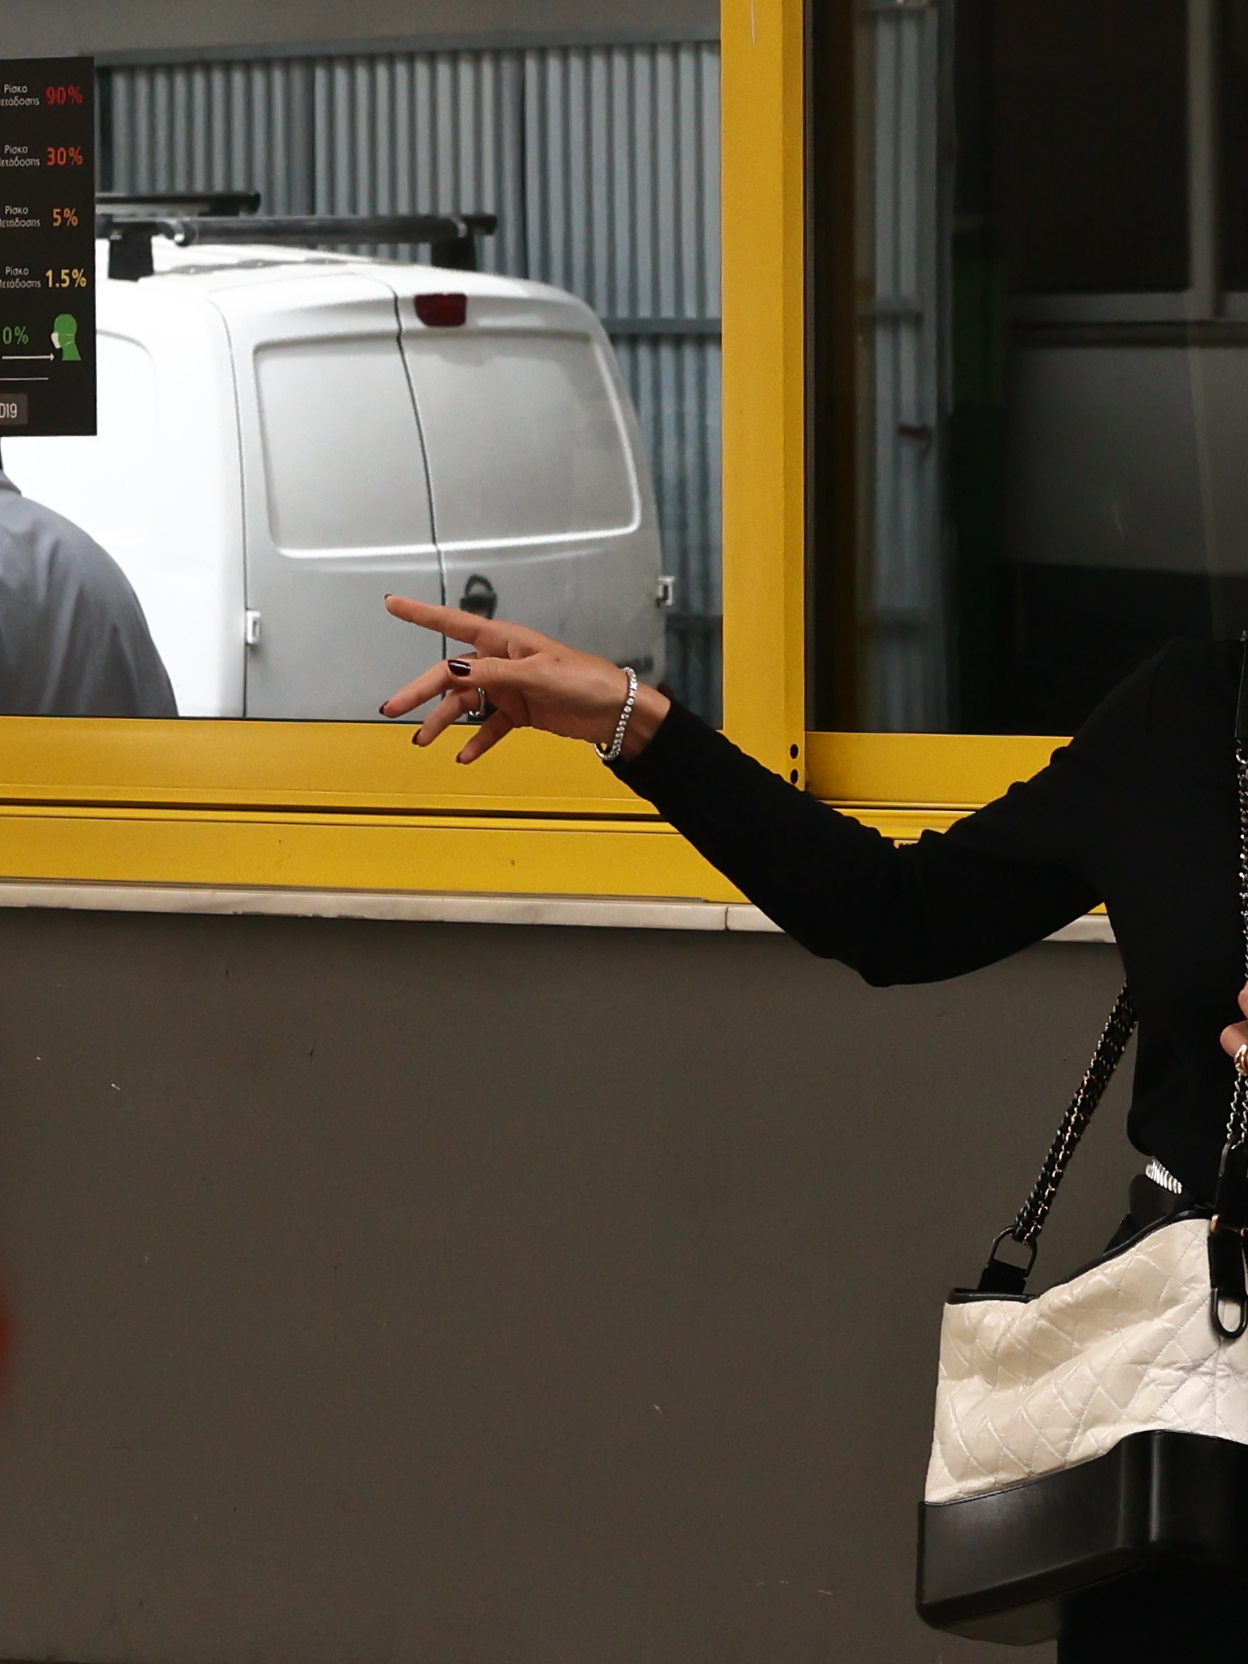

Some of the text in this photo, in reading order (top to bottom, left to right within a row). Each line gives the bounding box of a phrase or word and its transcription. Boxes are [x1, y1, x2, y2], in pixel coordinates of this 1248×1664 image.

[45, 85, 83, 104] 90%
[47, 147, 83, 165] 30%
[53, 208, 79, 227] 5%
[46, 268, 87, 288] 1.5%
[2, 326, 29, 346] 0%
